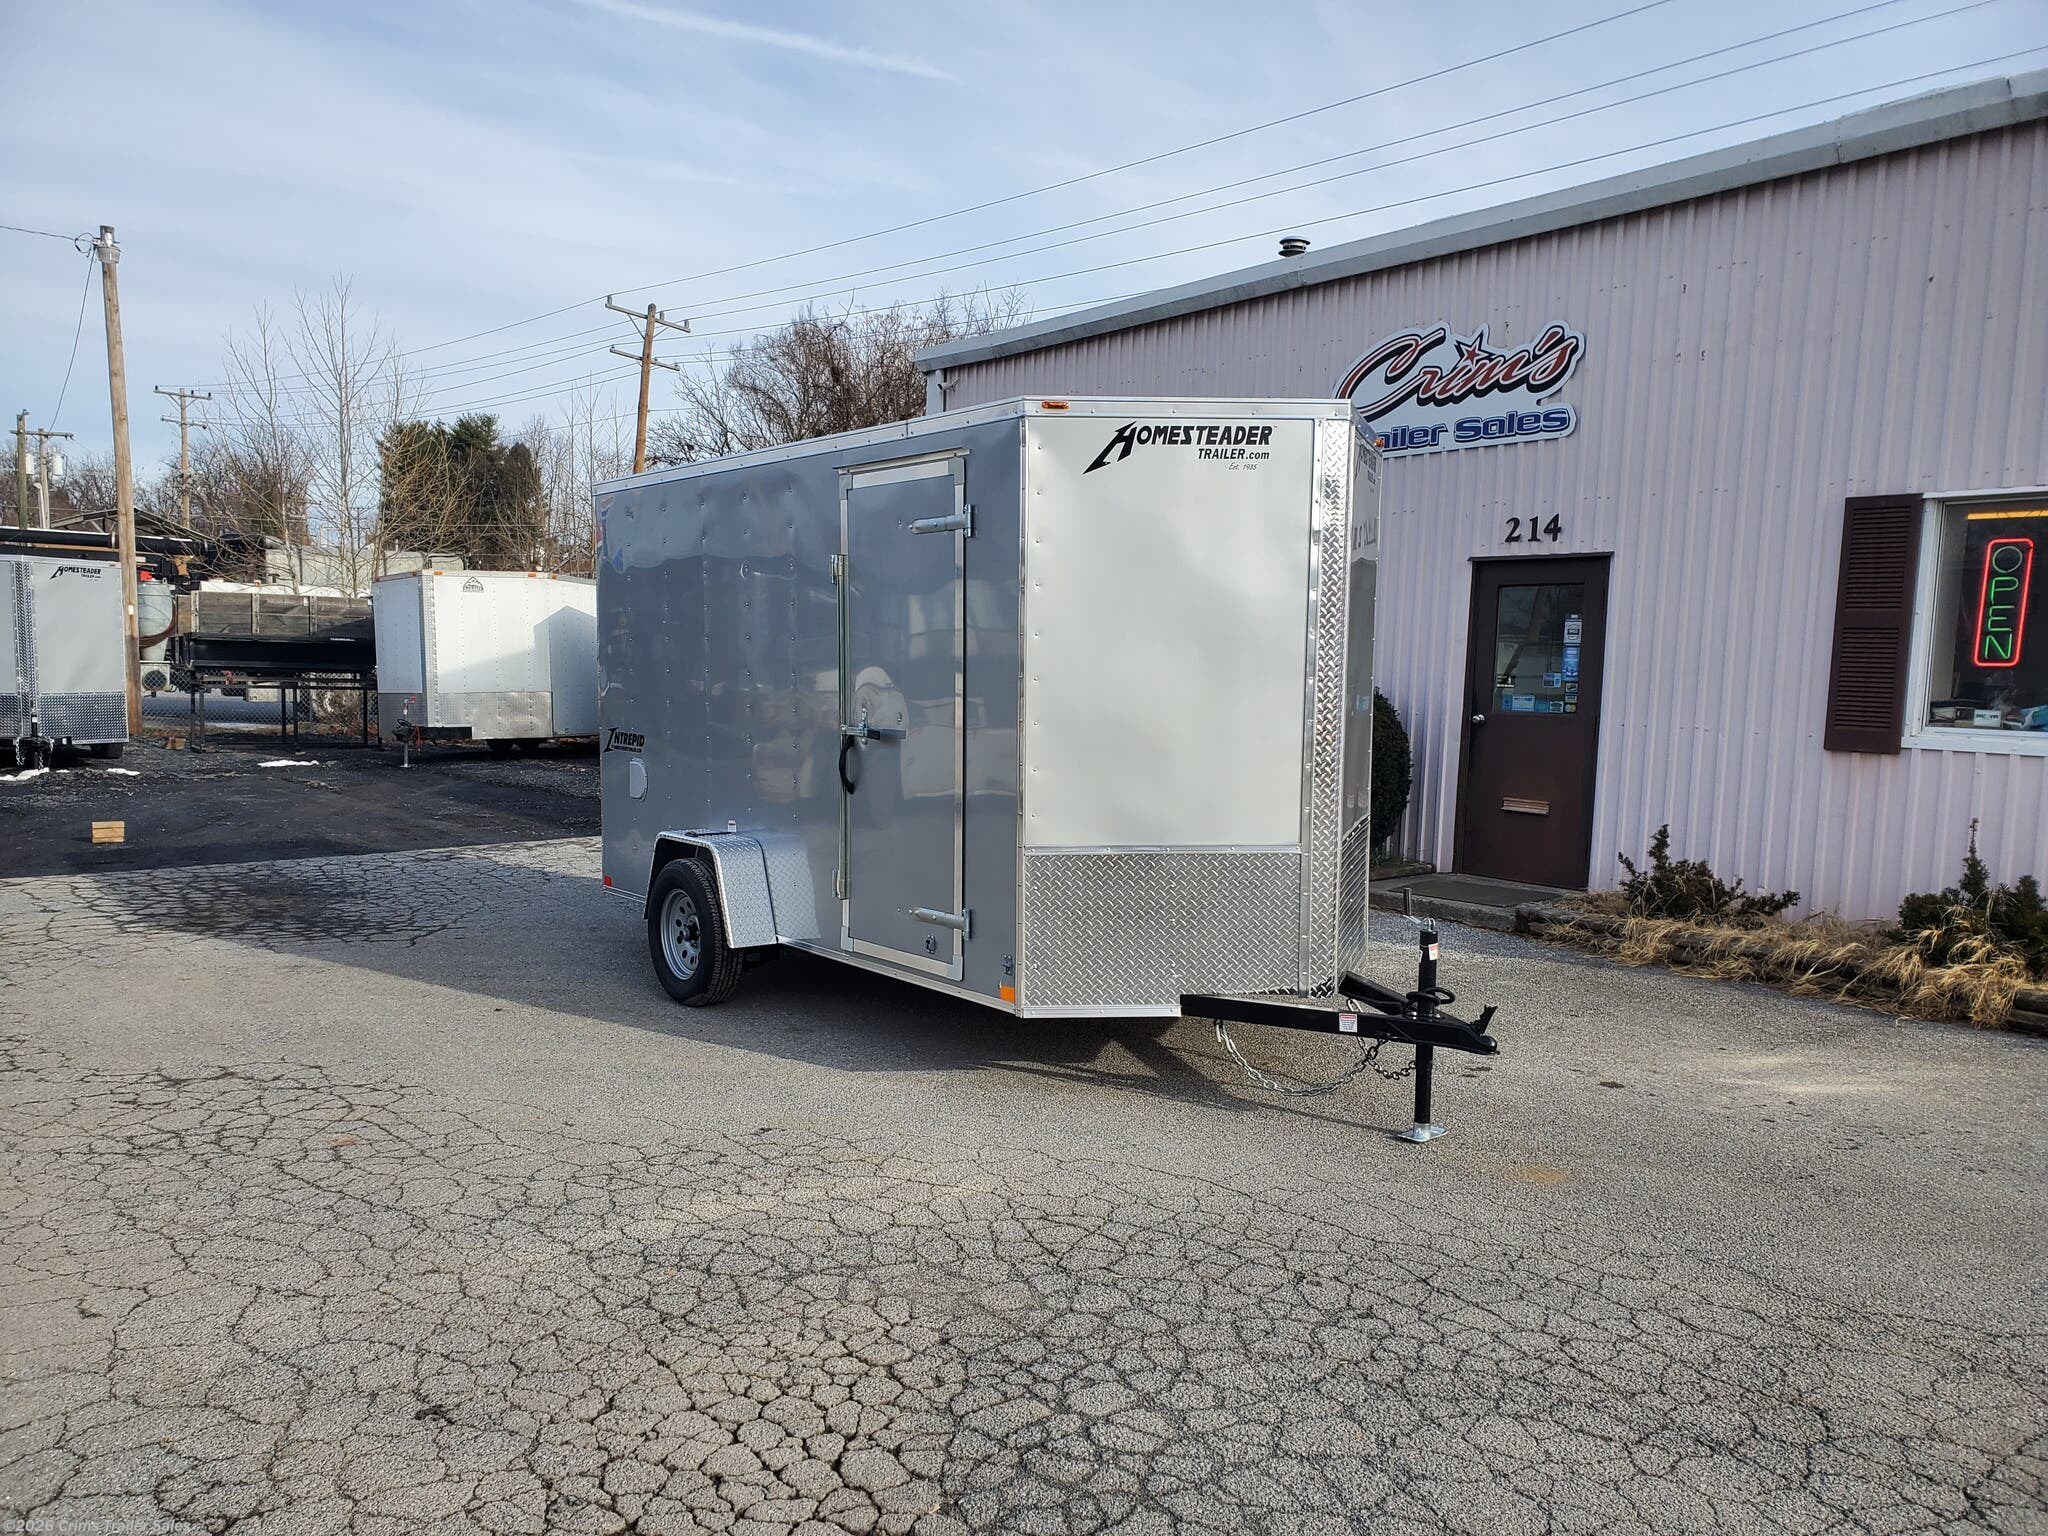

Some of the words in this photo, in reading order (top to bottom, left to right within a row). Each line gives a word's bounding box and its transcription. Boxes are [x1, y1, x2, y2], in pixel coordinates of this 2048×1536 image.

[1336, 325, 1578, 422] Crim's
[1453, 407, 1570, 443] Sales
[1083, 421, 1273, 474] HOMESTEADER
[1198, 448, 1270, 460] TRAILER.com
[1505, 514, 1562, 542] 214
[1985, 546, 2023, 660] OPEN
[603, 726, 646, 753] INTREPID
